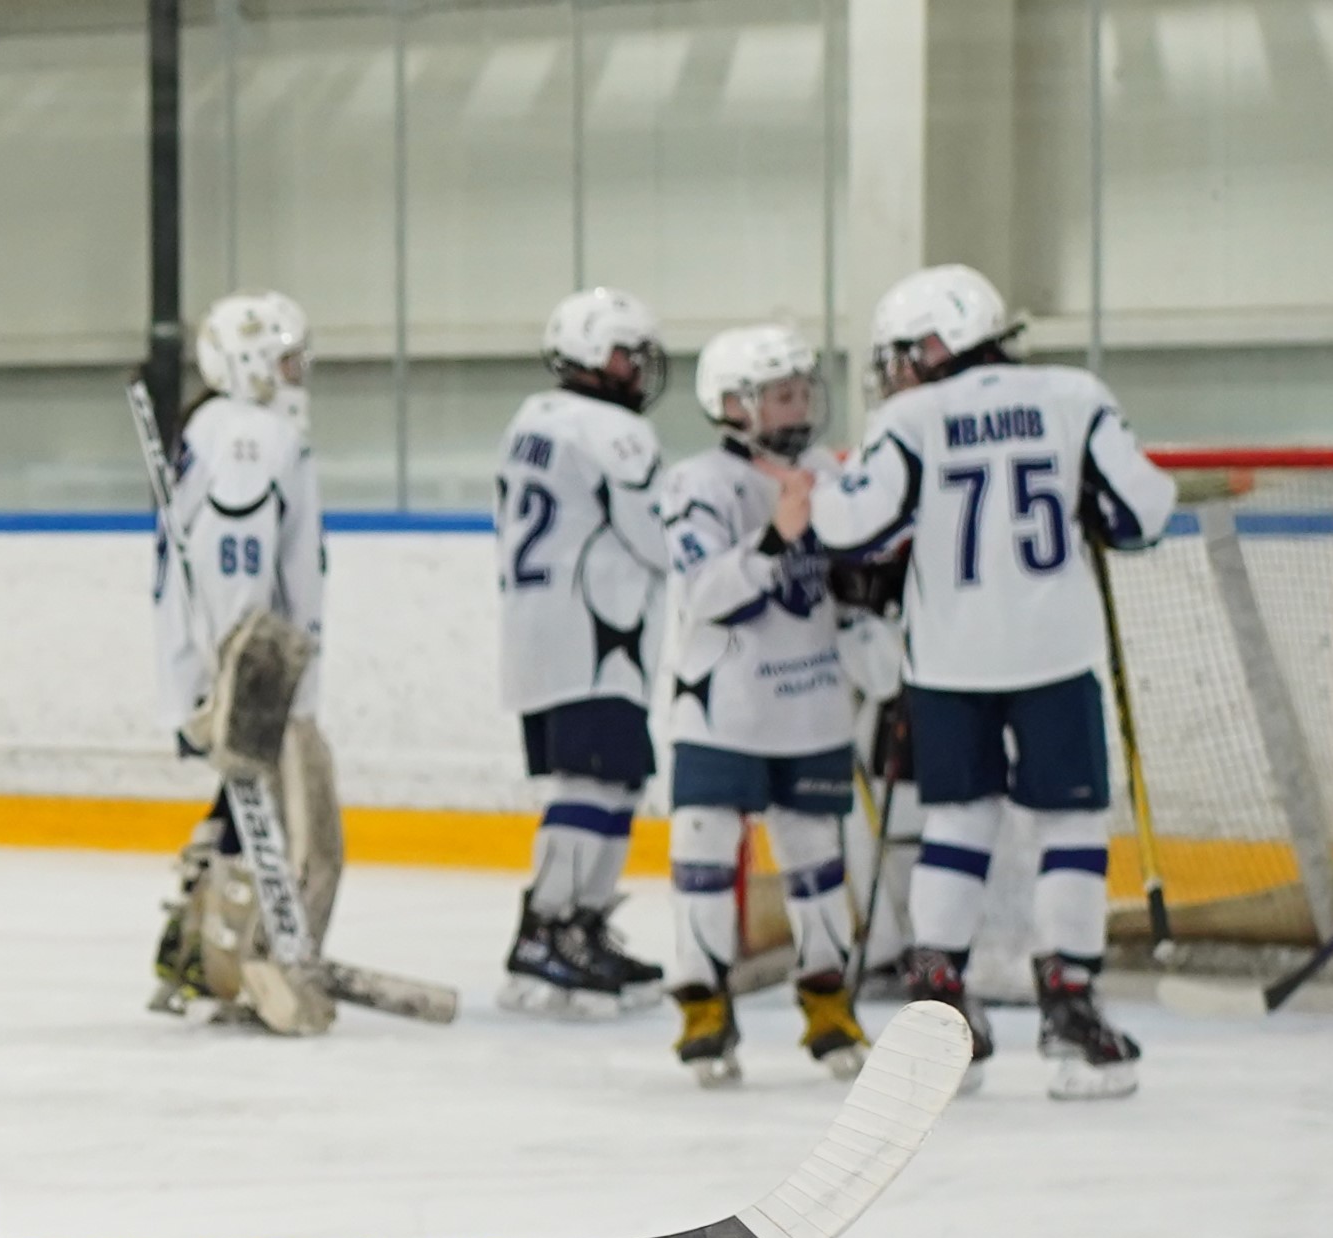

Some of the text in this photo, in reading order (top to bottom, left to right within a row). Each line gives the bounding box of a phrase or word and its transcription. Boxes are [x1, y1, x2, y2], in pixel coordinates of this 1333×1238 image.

[945, 405, 1045, 447] ИВАНОВ
[496, 476, 557, 588] 2
[940, 456, 1070, 587] 75
